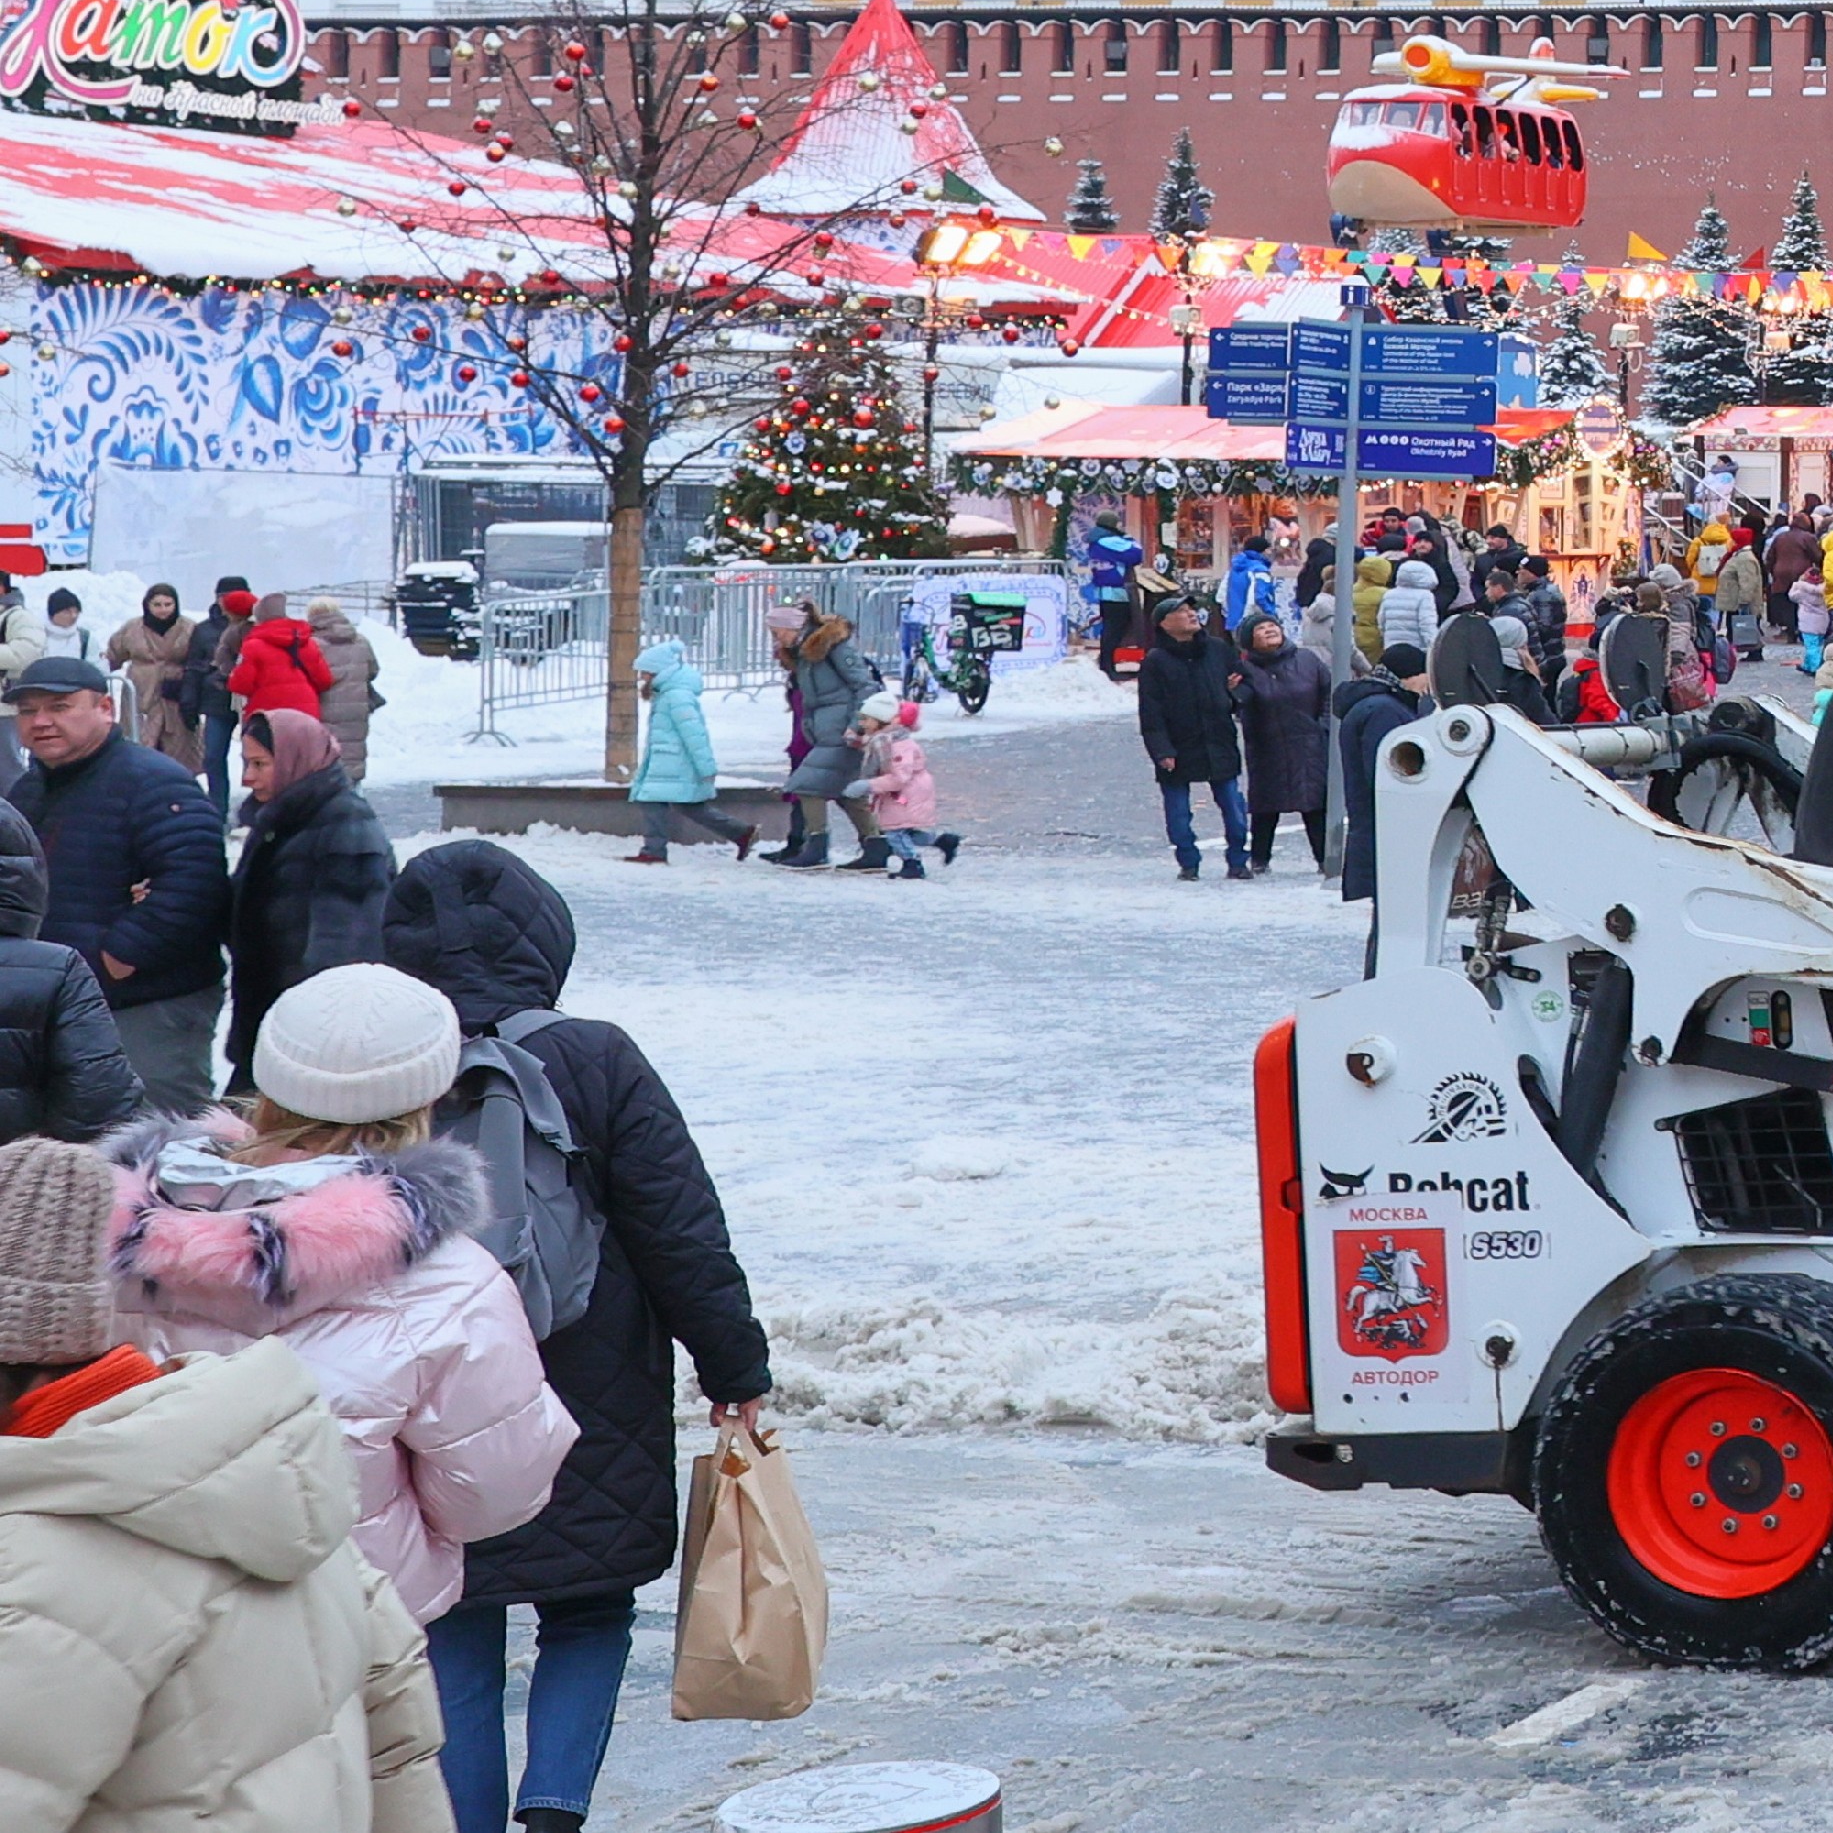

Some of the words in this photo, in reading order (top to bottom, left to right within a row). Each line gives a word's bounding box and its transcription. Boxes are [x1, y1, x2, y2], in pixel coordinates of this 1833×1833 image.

[131, 85, 164, 108] на
[163, 79, 257, 121] Красной
[1227, 382, 1252, 393] Парк
[1411, 436, 1455, 447] Охотный
[1457, 438, 1475, 450] Ряд
[1349, 1208, 1428, 1222] МОСКВА
[1471, 1229, 1543, 1260] S530
[1352, 1370, 1440, 1386] АВТОДОР
